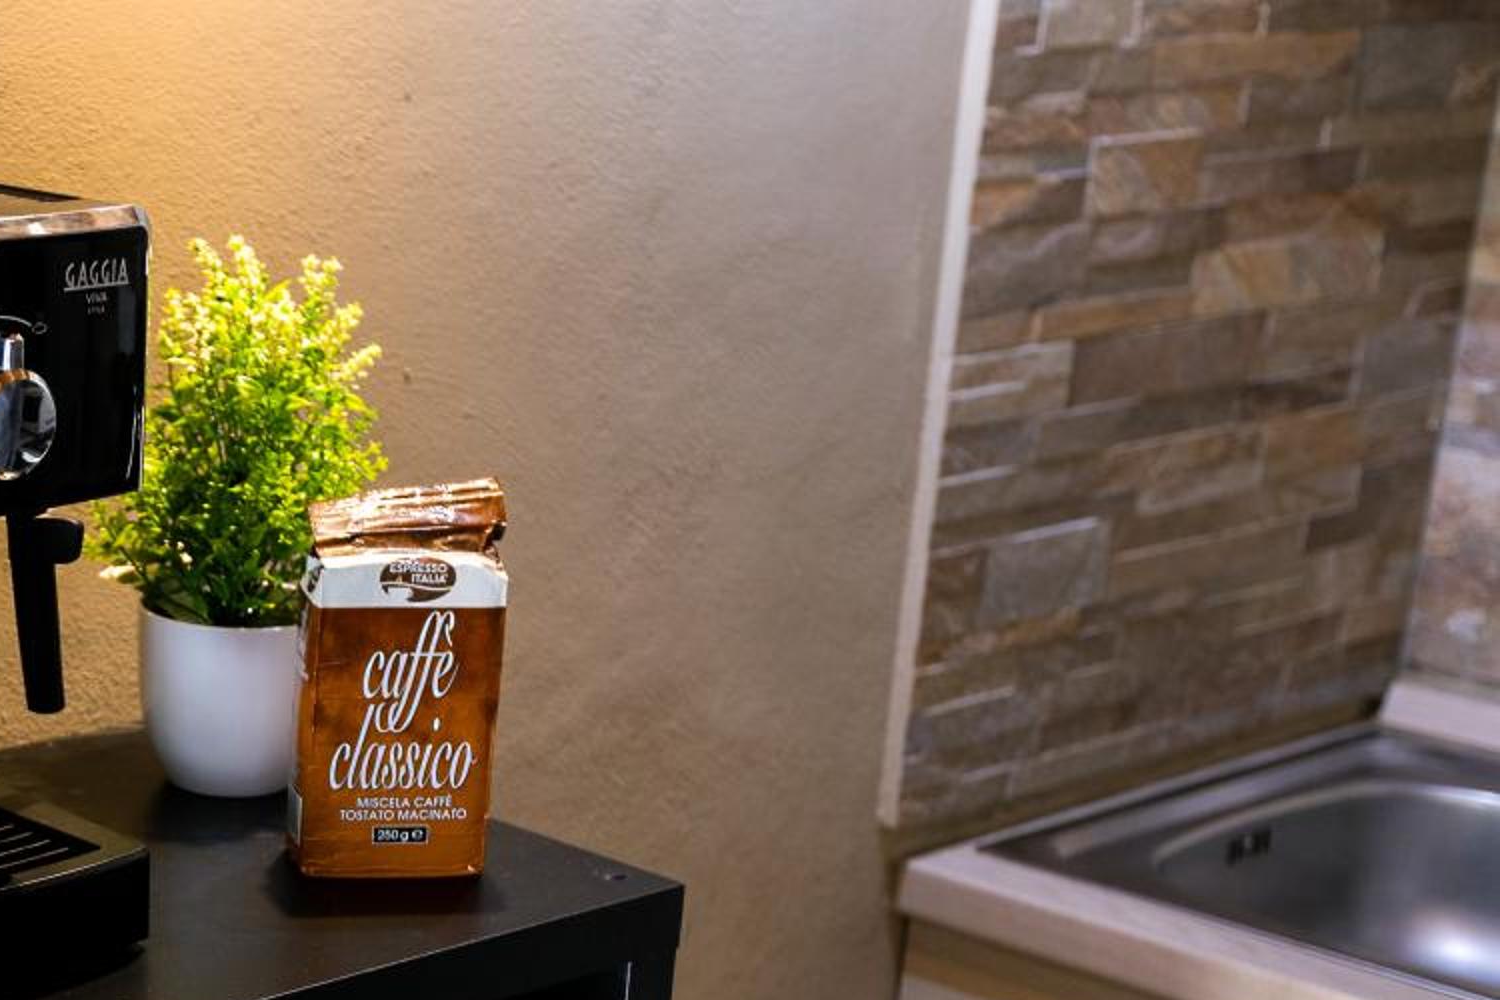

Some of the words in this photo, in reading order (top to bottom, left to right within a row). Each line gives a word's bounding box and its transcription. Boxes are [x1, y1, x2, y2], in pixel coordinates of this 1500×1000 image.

[64, 257, 129, 289] GAGGIA
[389, 558, 449, 573] ESPRESSO
[329, 703, 477, 791] classico
[356, 796, 411, 809] MISCELA
[413, 793, 453, 808] CAFFÈ
[340, 808, 395, 821] TOSTATO
[397, 807, 467, 820] MACINATO
[377, 829, 399, 841] 250
